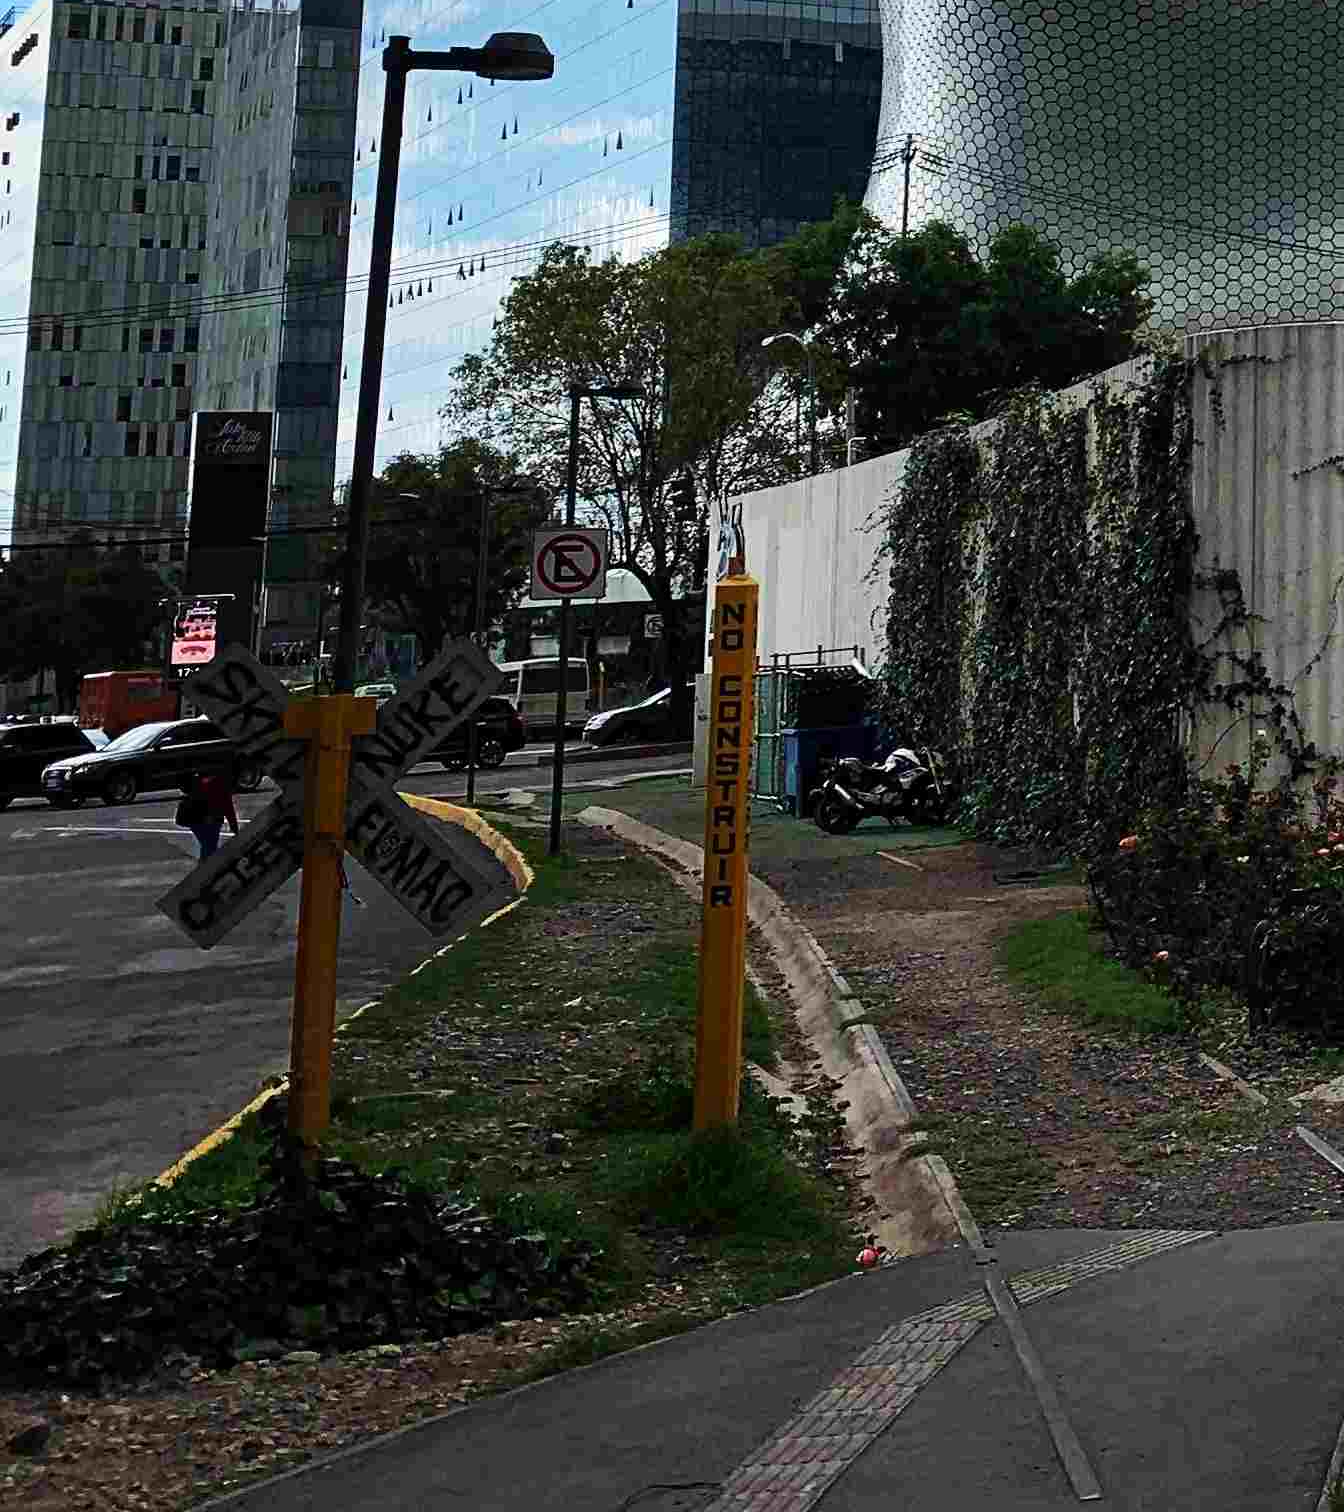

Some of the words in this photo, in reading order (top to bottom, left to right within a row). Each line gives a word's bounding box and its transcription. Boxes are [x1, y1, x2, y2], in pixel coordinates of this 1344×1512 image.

[722, 603, 746, 651] NO
[354, 671, 475, 776] NUKE
[712, 675, 742, 907] CONSTRUIR
